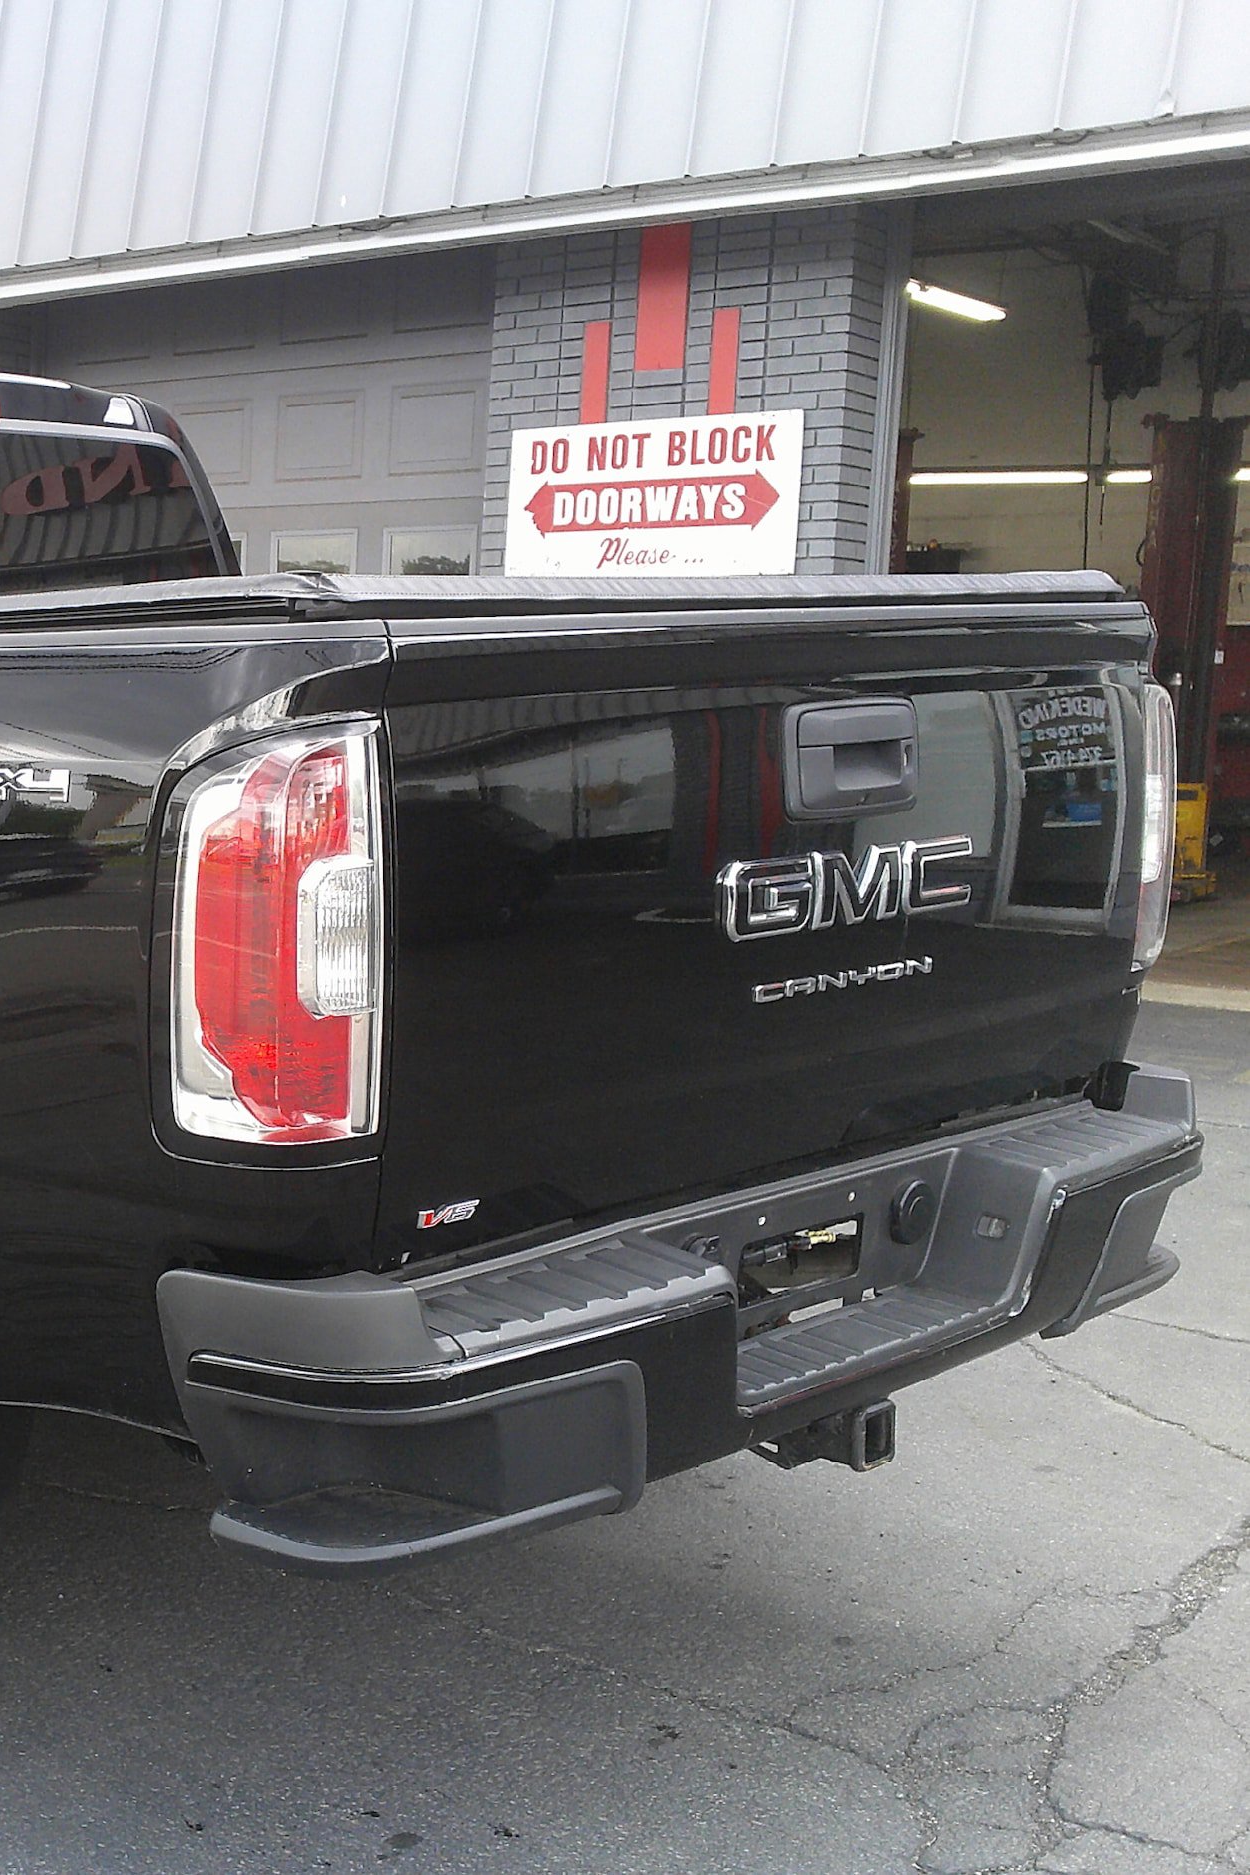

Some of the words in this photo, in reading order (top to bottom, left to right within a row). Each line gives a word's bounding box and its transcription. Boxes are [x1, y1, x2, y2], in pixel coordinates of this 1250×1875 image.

[531, 438, 569, 475] DO
[587, 432, 651, 471] NOT
[668, 425, 776, 466] BLOCK
[552, 482, 747, 527] DOORWAYS
[596, 537, 672, 569] Please
[715, 834, 972, 942] GMC
[752, 955, 933, 1003] CANYON
[417, 1199, 480, 1229] V6
